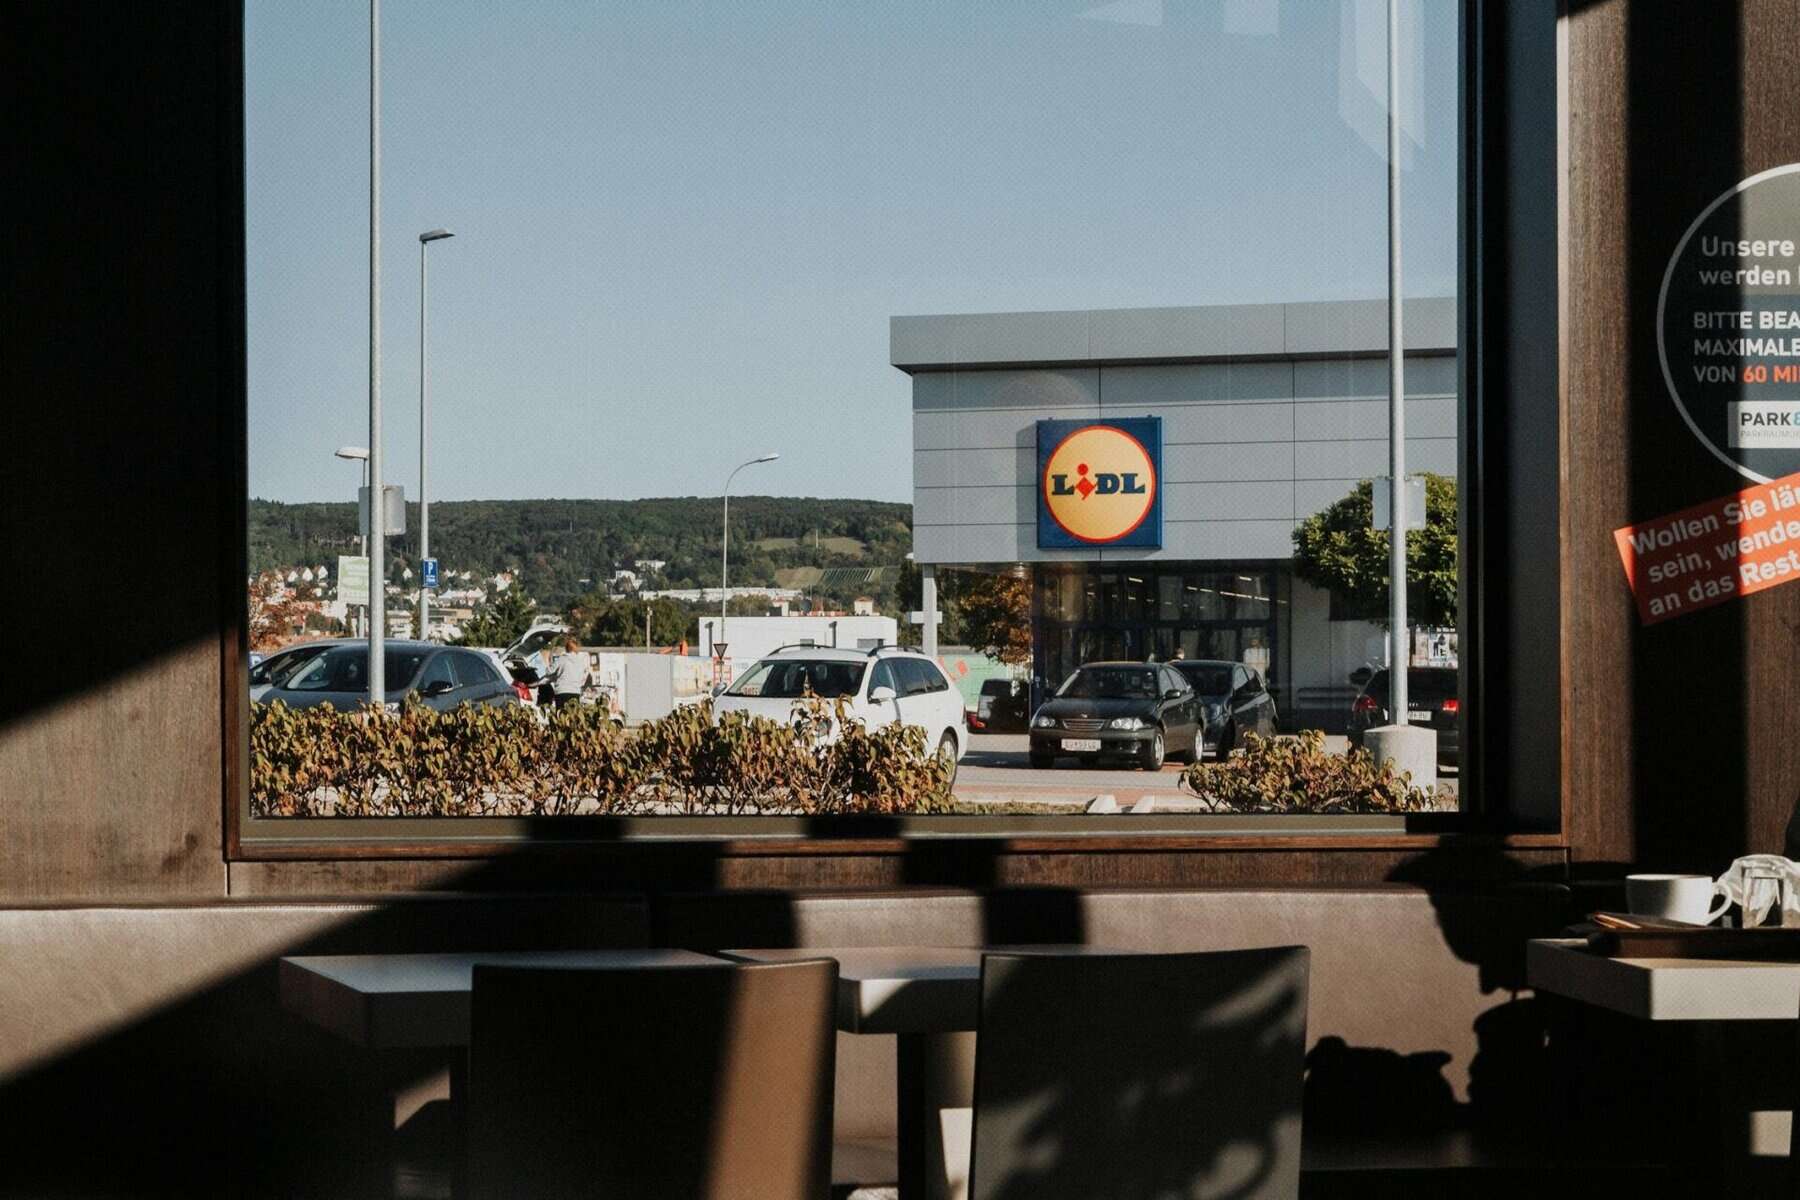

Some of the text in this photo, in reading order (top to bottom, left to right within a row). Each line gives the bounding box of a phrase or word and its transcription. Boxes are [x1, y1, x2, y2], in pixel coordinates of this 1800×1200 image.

[1702, 235, 1795, 257] Unsere
[1699, 264, 1791, 286] werden
[1693, 311, 1753, 329] BITTE
[1693, 338, 1800, 356] MAXIMALE
[1693, 365, 1736, 383] VON
[1743, 365, 1767, 383] 60
[1628, 514, 1720, 556] Wollen
[1723, 498, 1767, 526] Sie
[1648, 520, 1800, 583] sein, wende
[1648, 550, 1800, 616] an das Rest
